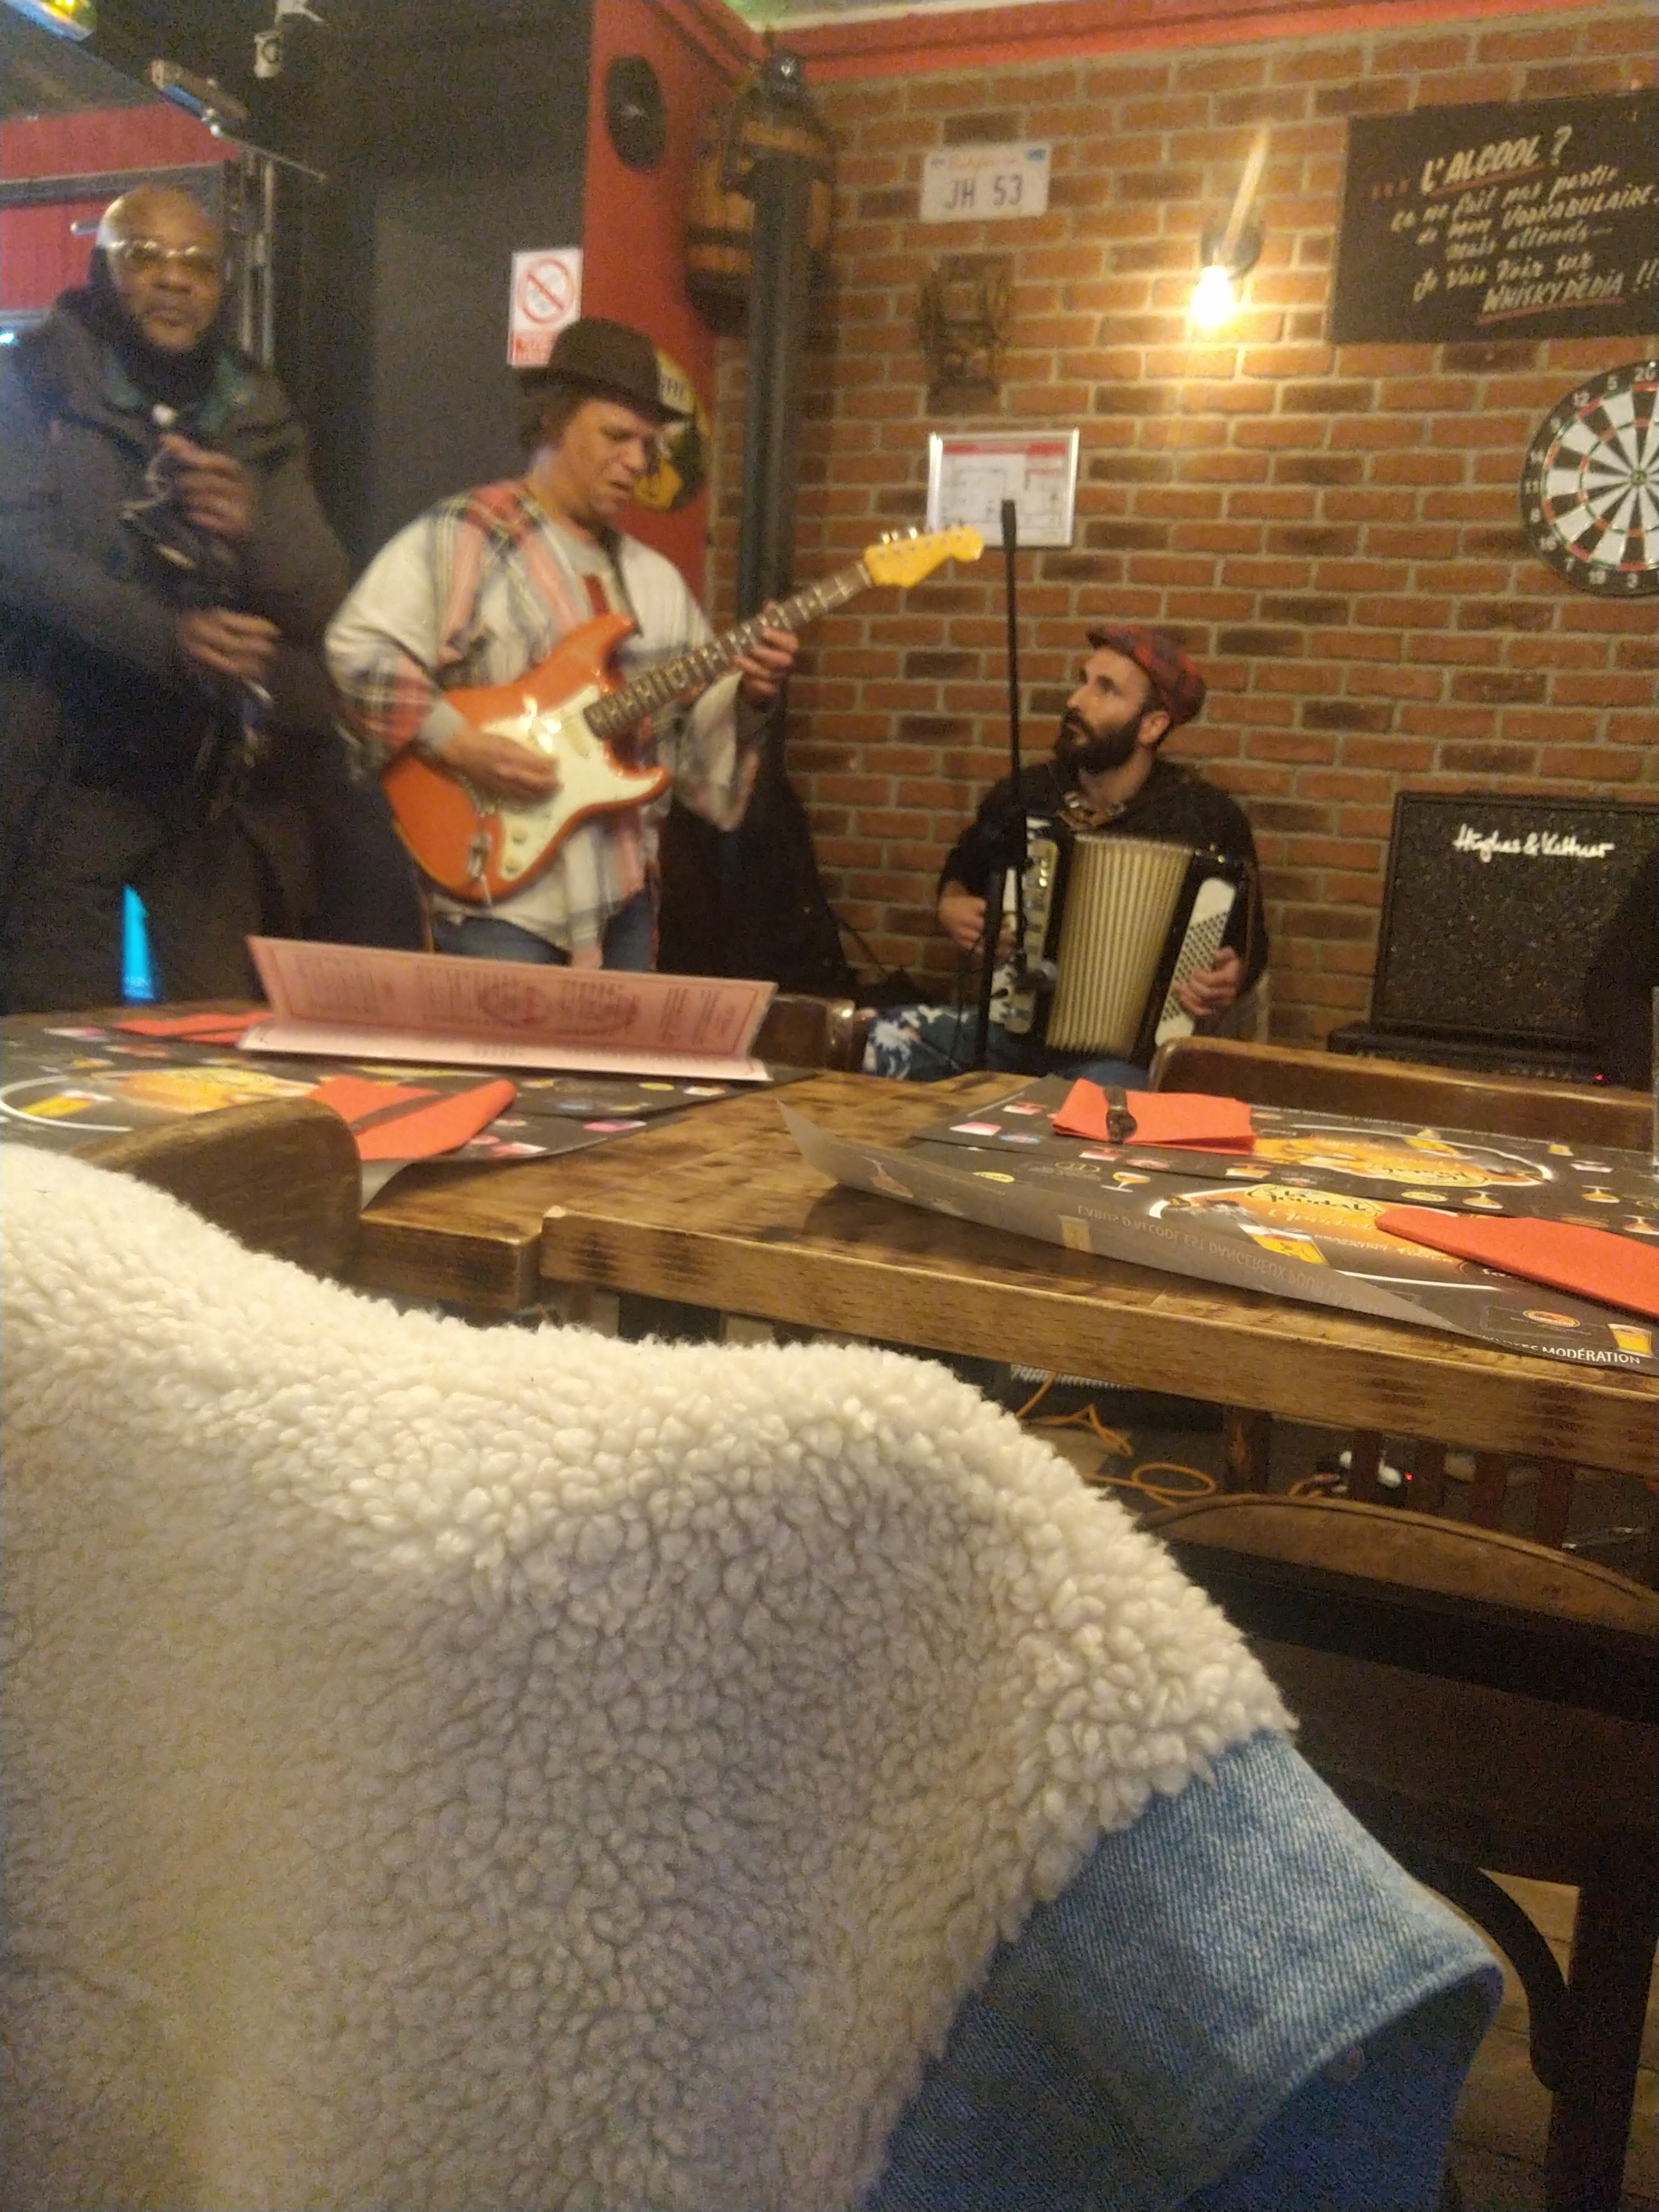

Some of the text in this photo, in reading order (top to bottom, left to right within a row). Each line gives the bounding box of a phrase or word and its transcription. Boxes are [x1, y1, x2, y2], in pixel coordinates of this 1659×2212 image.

[1551, 125, 1572, 166] ?
[1501, 181, 1543, 209] pas
[1548, 164, 1619, 202] partie
[1607, 376, 1619, 391] 5
[1634, 367, 1656, 382] 20
[1523, 832, 1540, 857] &
[1542, 1346, 1641, 1364] MODÉRATION
